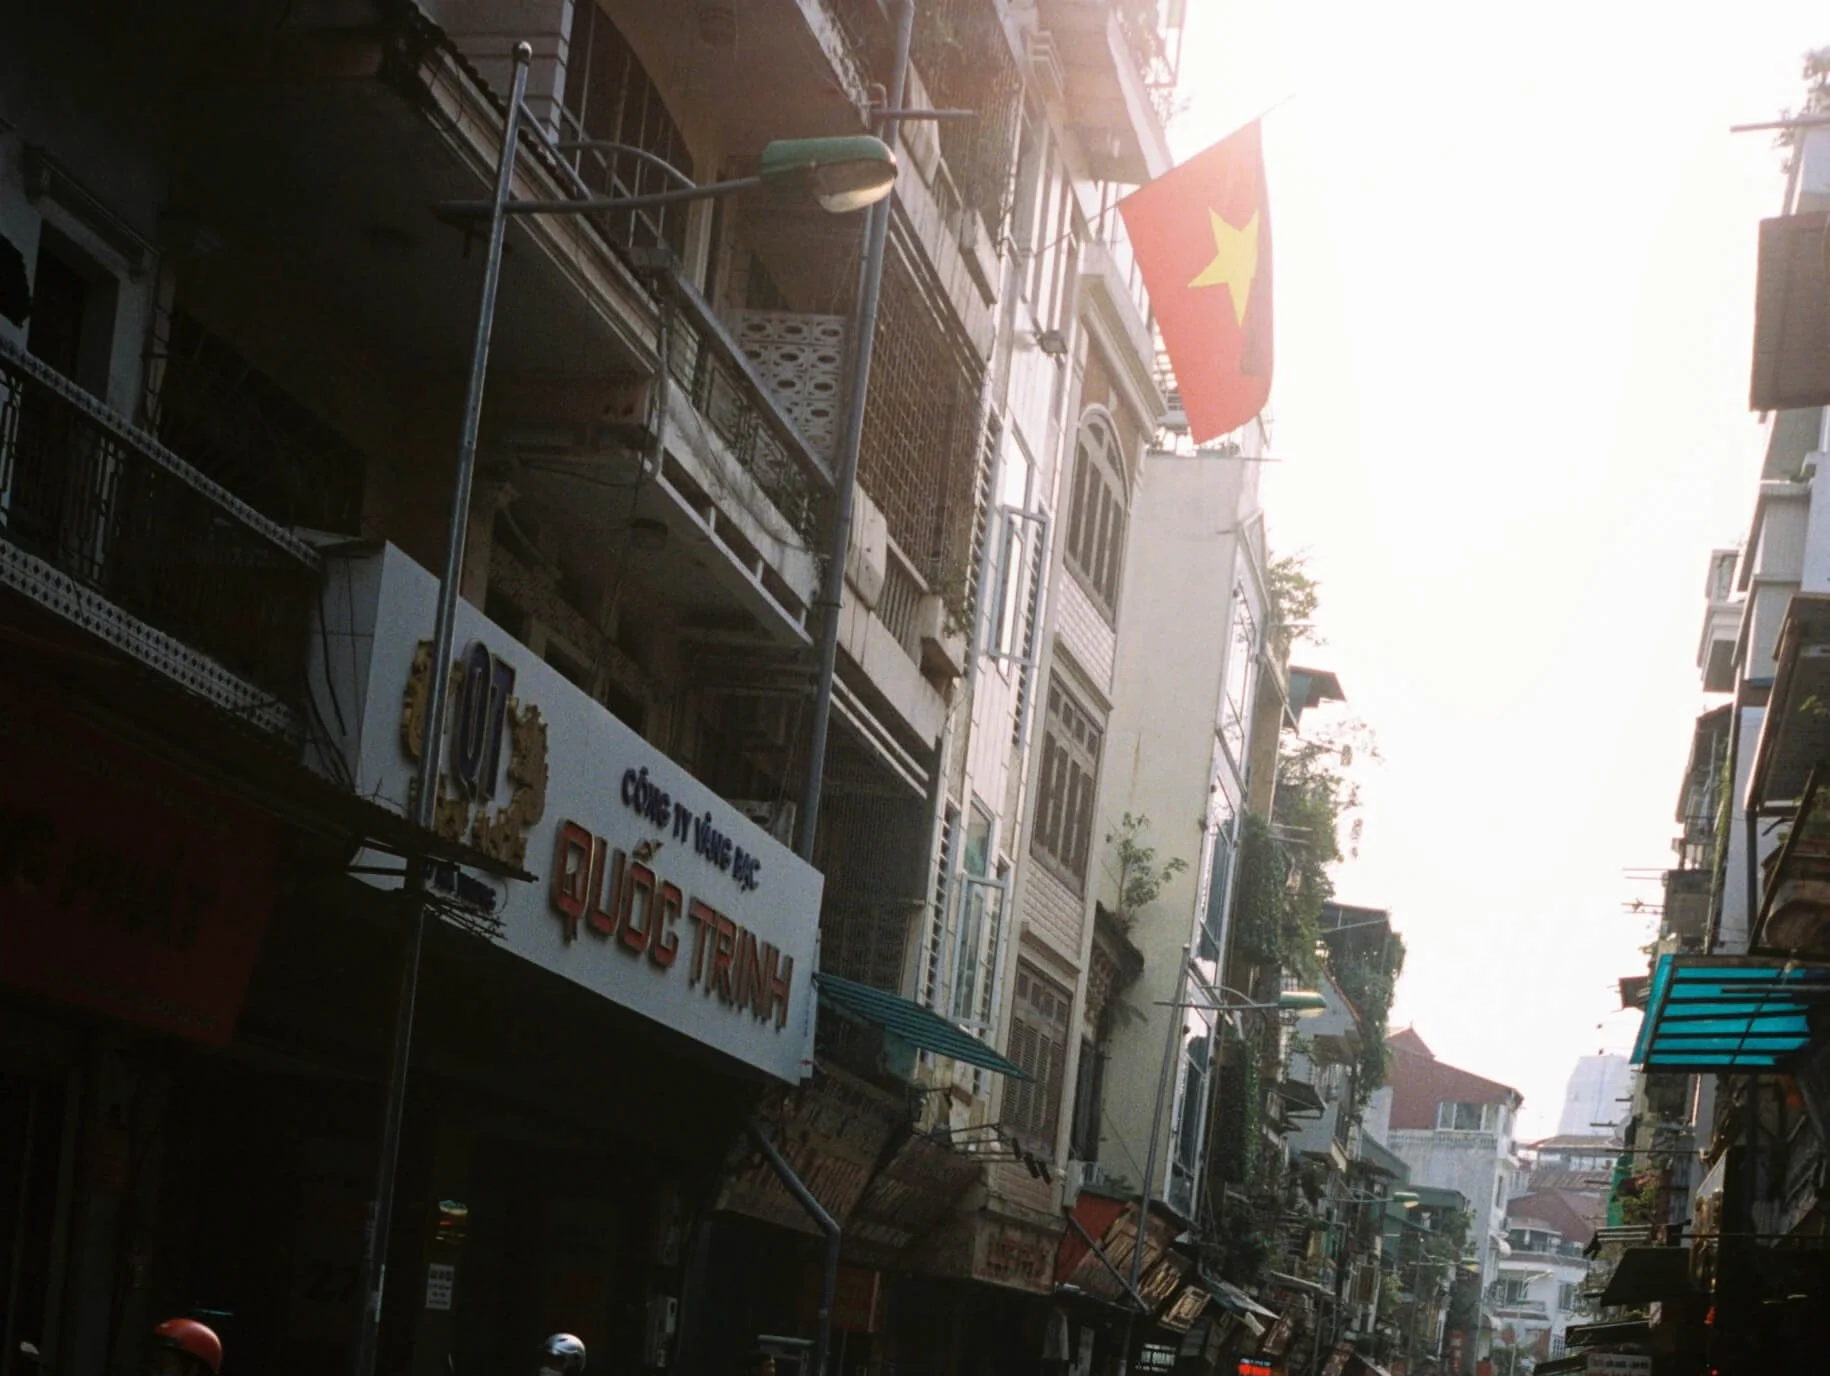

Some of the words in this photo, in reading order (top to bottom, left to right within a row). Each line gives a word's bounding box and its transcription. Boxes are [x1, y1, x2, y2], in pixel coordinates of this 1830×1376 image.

[621, 764, 671, 829] CÔNG
[672, 802, 693, 844] TY
[550, 819, 683, 969] QUỐC
[689, 897, 794, 1033] TRINH
